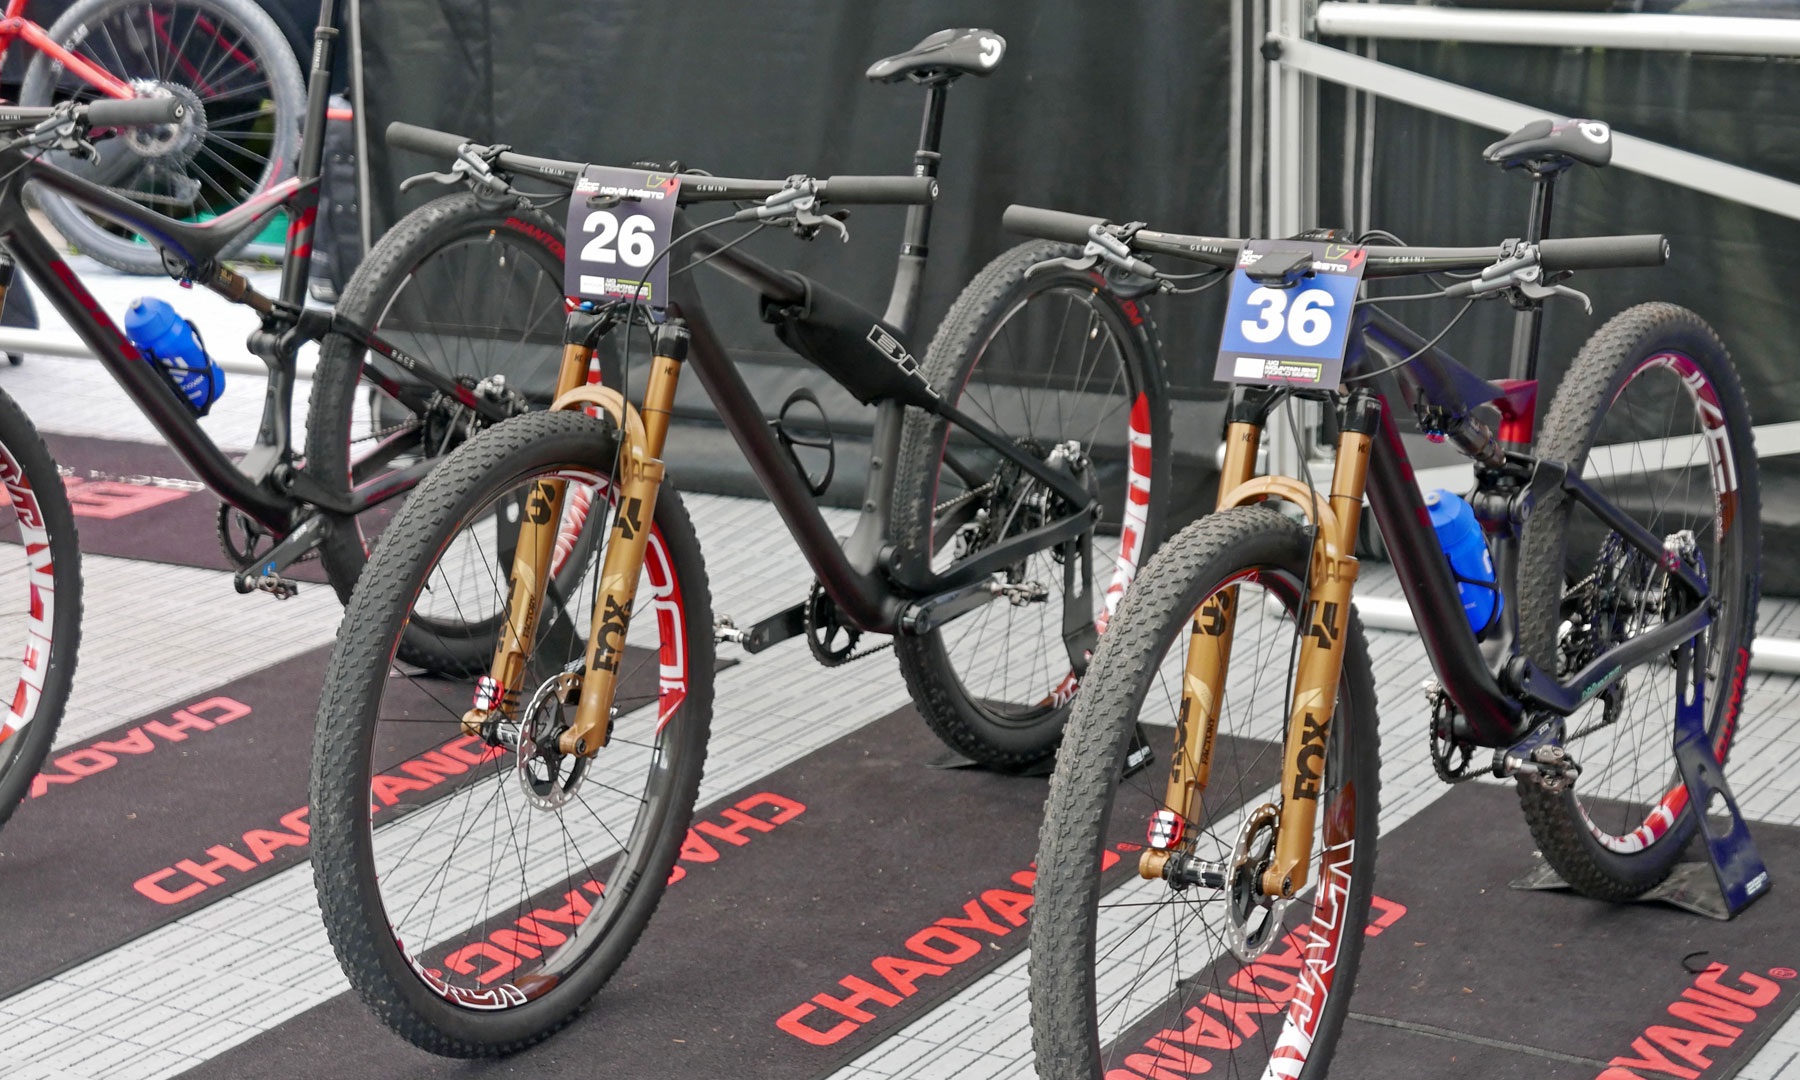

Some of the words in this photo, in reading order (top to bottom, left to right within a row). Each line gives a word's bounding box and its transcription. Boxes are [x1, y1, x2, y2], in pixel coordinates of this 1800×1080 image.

[539, 166, 566, 176] GEMINI
[696, 184, 728, 192] GEMINI
[503, 216, 566, 264] PHANTO
[580, 210, 656, 268] 26
[1189, 244, 1223, 254] GEMINI
[1387, 256, 1426, 264] GEMINI
[1240, 286, 1336, 347] 36
[391, 349, 417, 370] RACE
[592, 595, 633, 676] FOX
[1712, 647, 1749, 765] PHANTO
[30, 696, 252, 800] CHAOY
[1202, 718, 1215, 766] FACTORY
[1293, 712, 1331, 801] FOX
[133, 735, 507, 904] CHAANG
[443, 792, 807, 985] CHAANG
